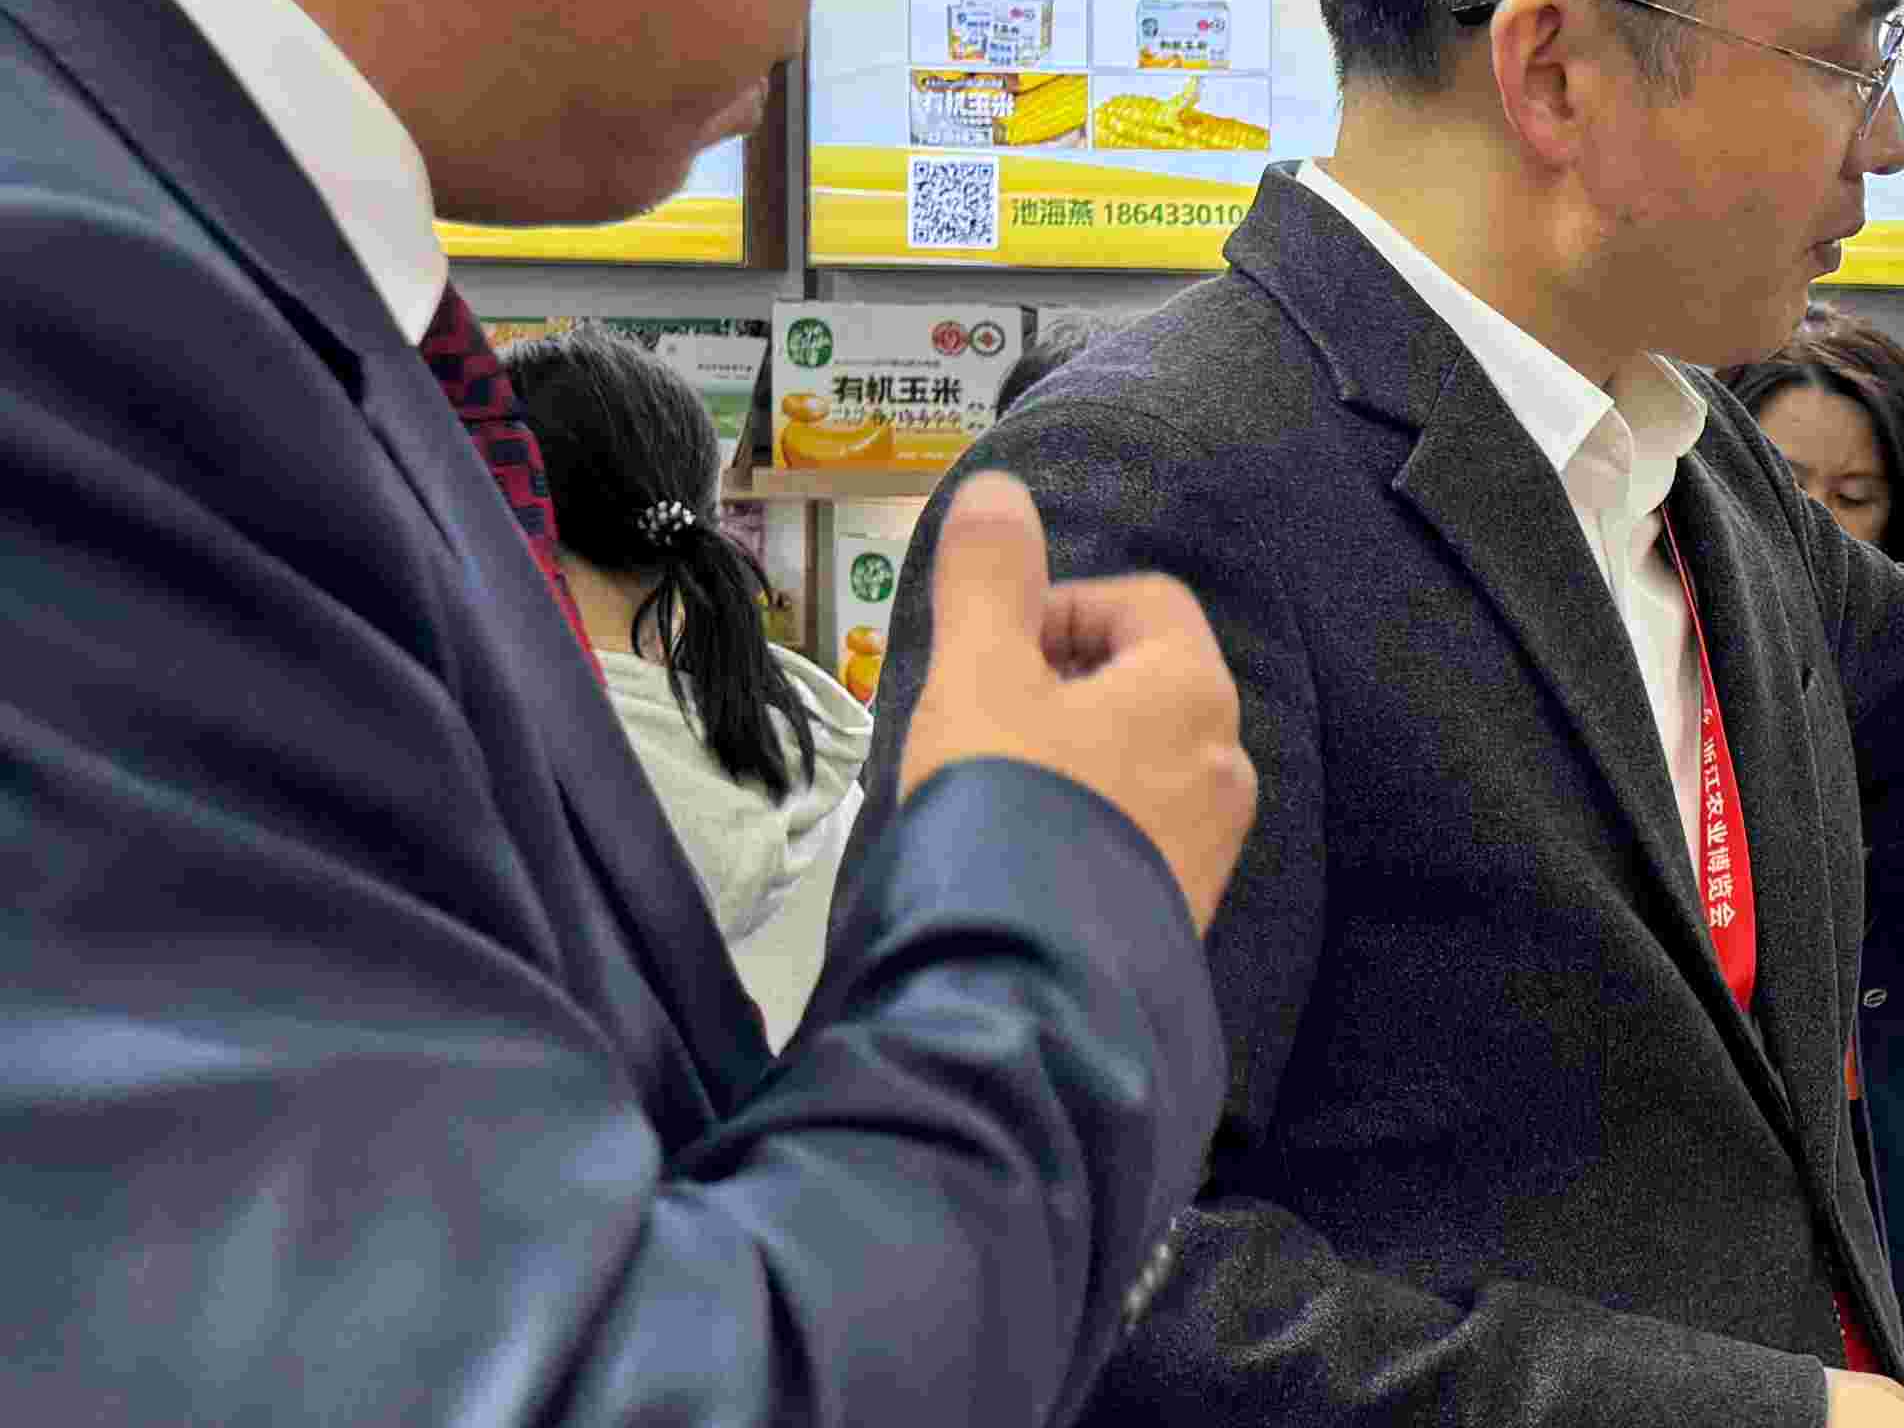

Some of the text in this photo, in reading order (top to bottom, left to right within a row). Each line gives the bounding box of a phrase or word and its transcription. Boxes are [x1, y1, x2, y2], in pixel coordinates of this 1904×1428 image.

[832, 375, 963, 405] 有机玉米
[1703, 736, 1736, 929] 浙江农业博览会
